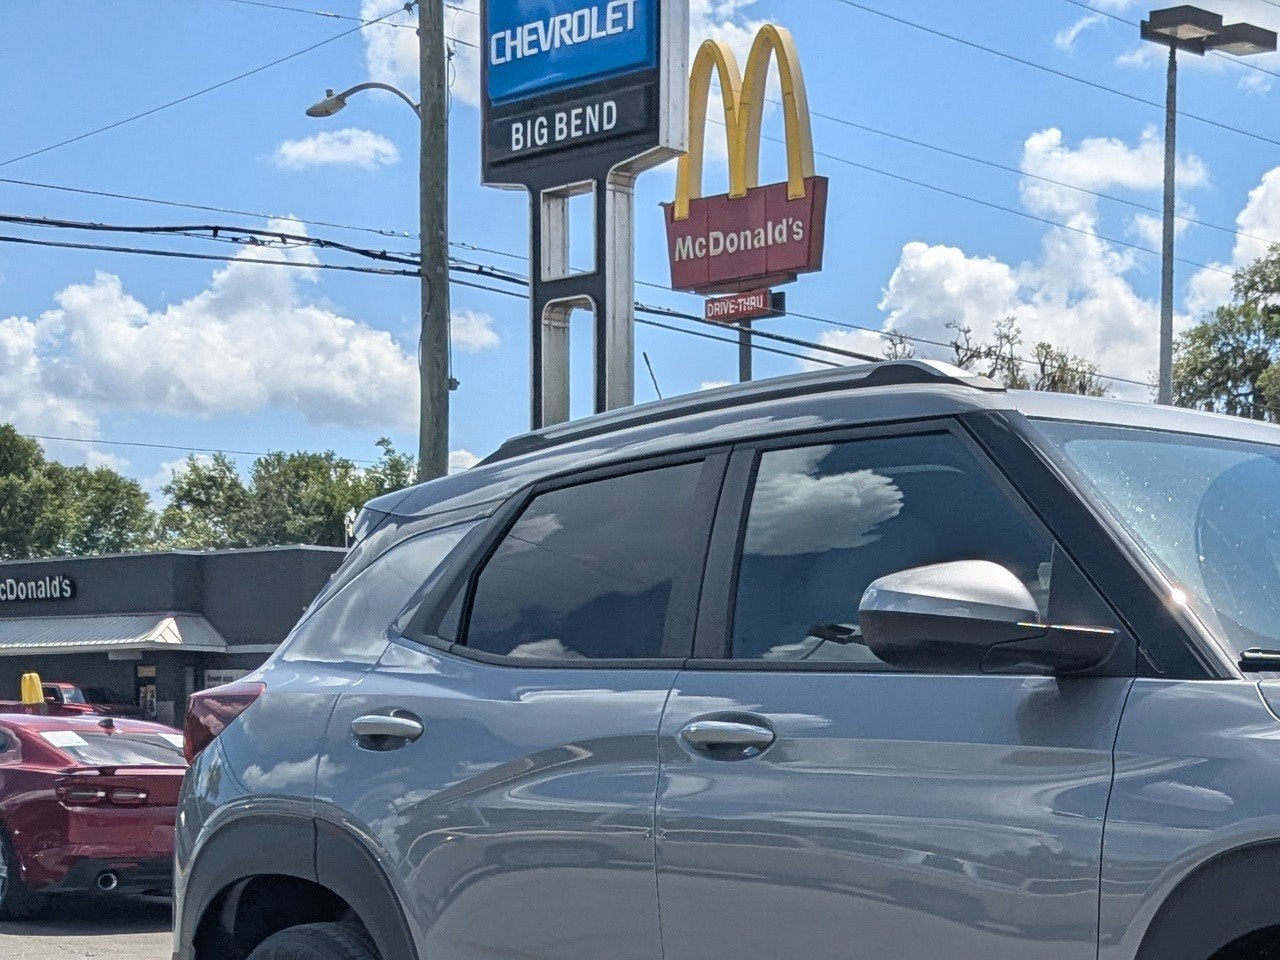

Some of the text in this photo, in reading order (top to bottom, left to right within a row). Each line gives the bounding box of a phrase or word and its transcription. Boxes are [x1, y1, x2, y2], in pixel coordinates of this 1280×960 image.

[490, 0, 636, 65] CHEVROLET
[511, 100, 617, 151] BIG BEND
[674, 217, 804, 262] McDonald's
[707, 295, 764, 317] DRIVE-THRU
[0, 575, 71, 600] cDonald's
